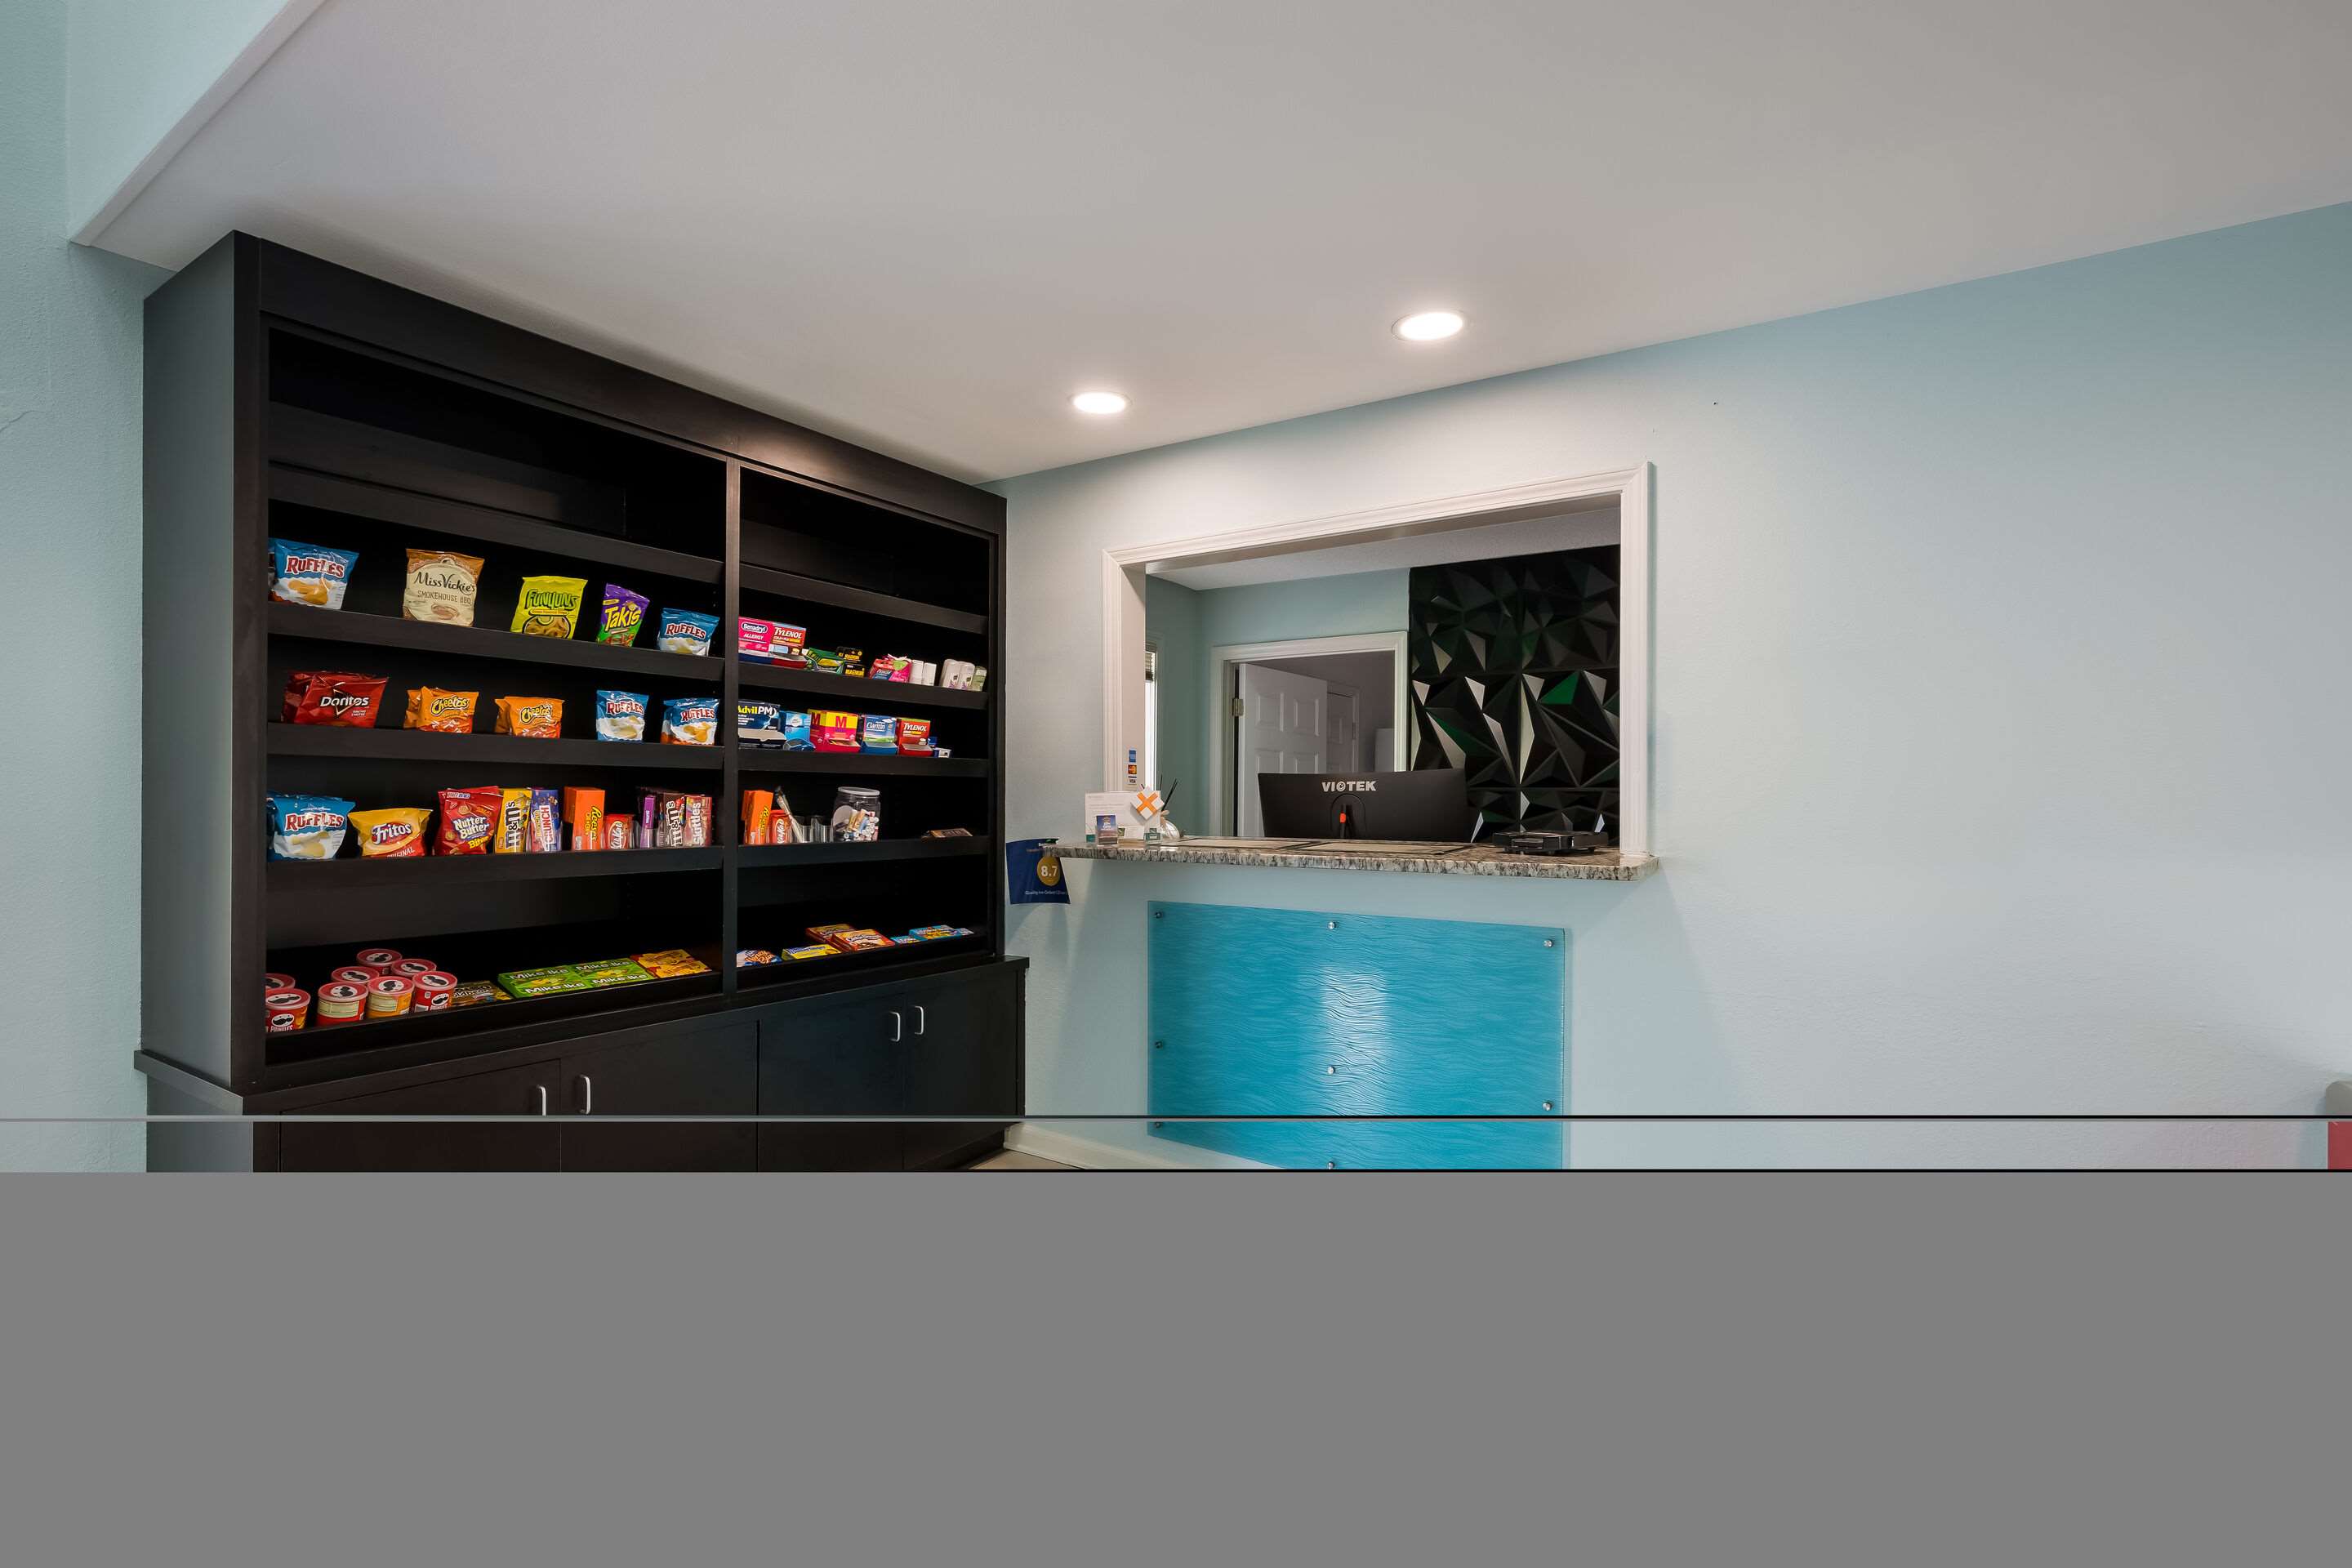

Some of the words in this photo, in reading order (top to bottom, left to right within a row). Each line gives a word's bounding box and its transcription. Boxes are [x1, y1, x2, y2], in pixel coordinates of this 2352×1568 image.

[286, 556, 345, 578] RUFFLES
[414, 572, 442, 587] Miss
[442, 574, 475, 595] Vickie's
[417, 590, 458, 603] SMOKEHOUSE
[460, 595, 472, 605] BBQ
[604, 606, 642, 631] Takis
[666, 622, 706, 639] RUFFLES
[774, 626, 802, 639] TYLENOL
[320, 696, 369, 707] Doritos
[431, 697, 470, 715] Cheetos
[606, 701, 645, 715] RUFFLES
[520, 703, 553, 724] Cheetos
[680, 708, 715, 722] RUFFLES
[835, 716, 847, 728] M
[903, 723, 927, 732] TYLENOL
[285, 813, 345, 831] RUFFLES
[453, 817, 487, 830] Nutter
[541, 807, 554, 843] CRUNCH
[372, 823, 412, 844] Fritos
[460, 823, 490, 840] Butter
[468, 836, 489, 849] Bites
[1041, 866, 1058, 876] 8.7
[509, 971, 546, 980] Mike
[524, 985, 563, 994] Mike
